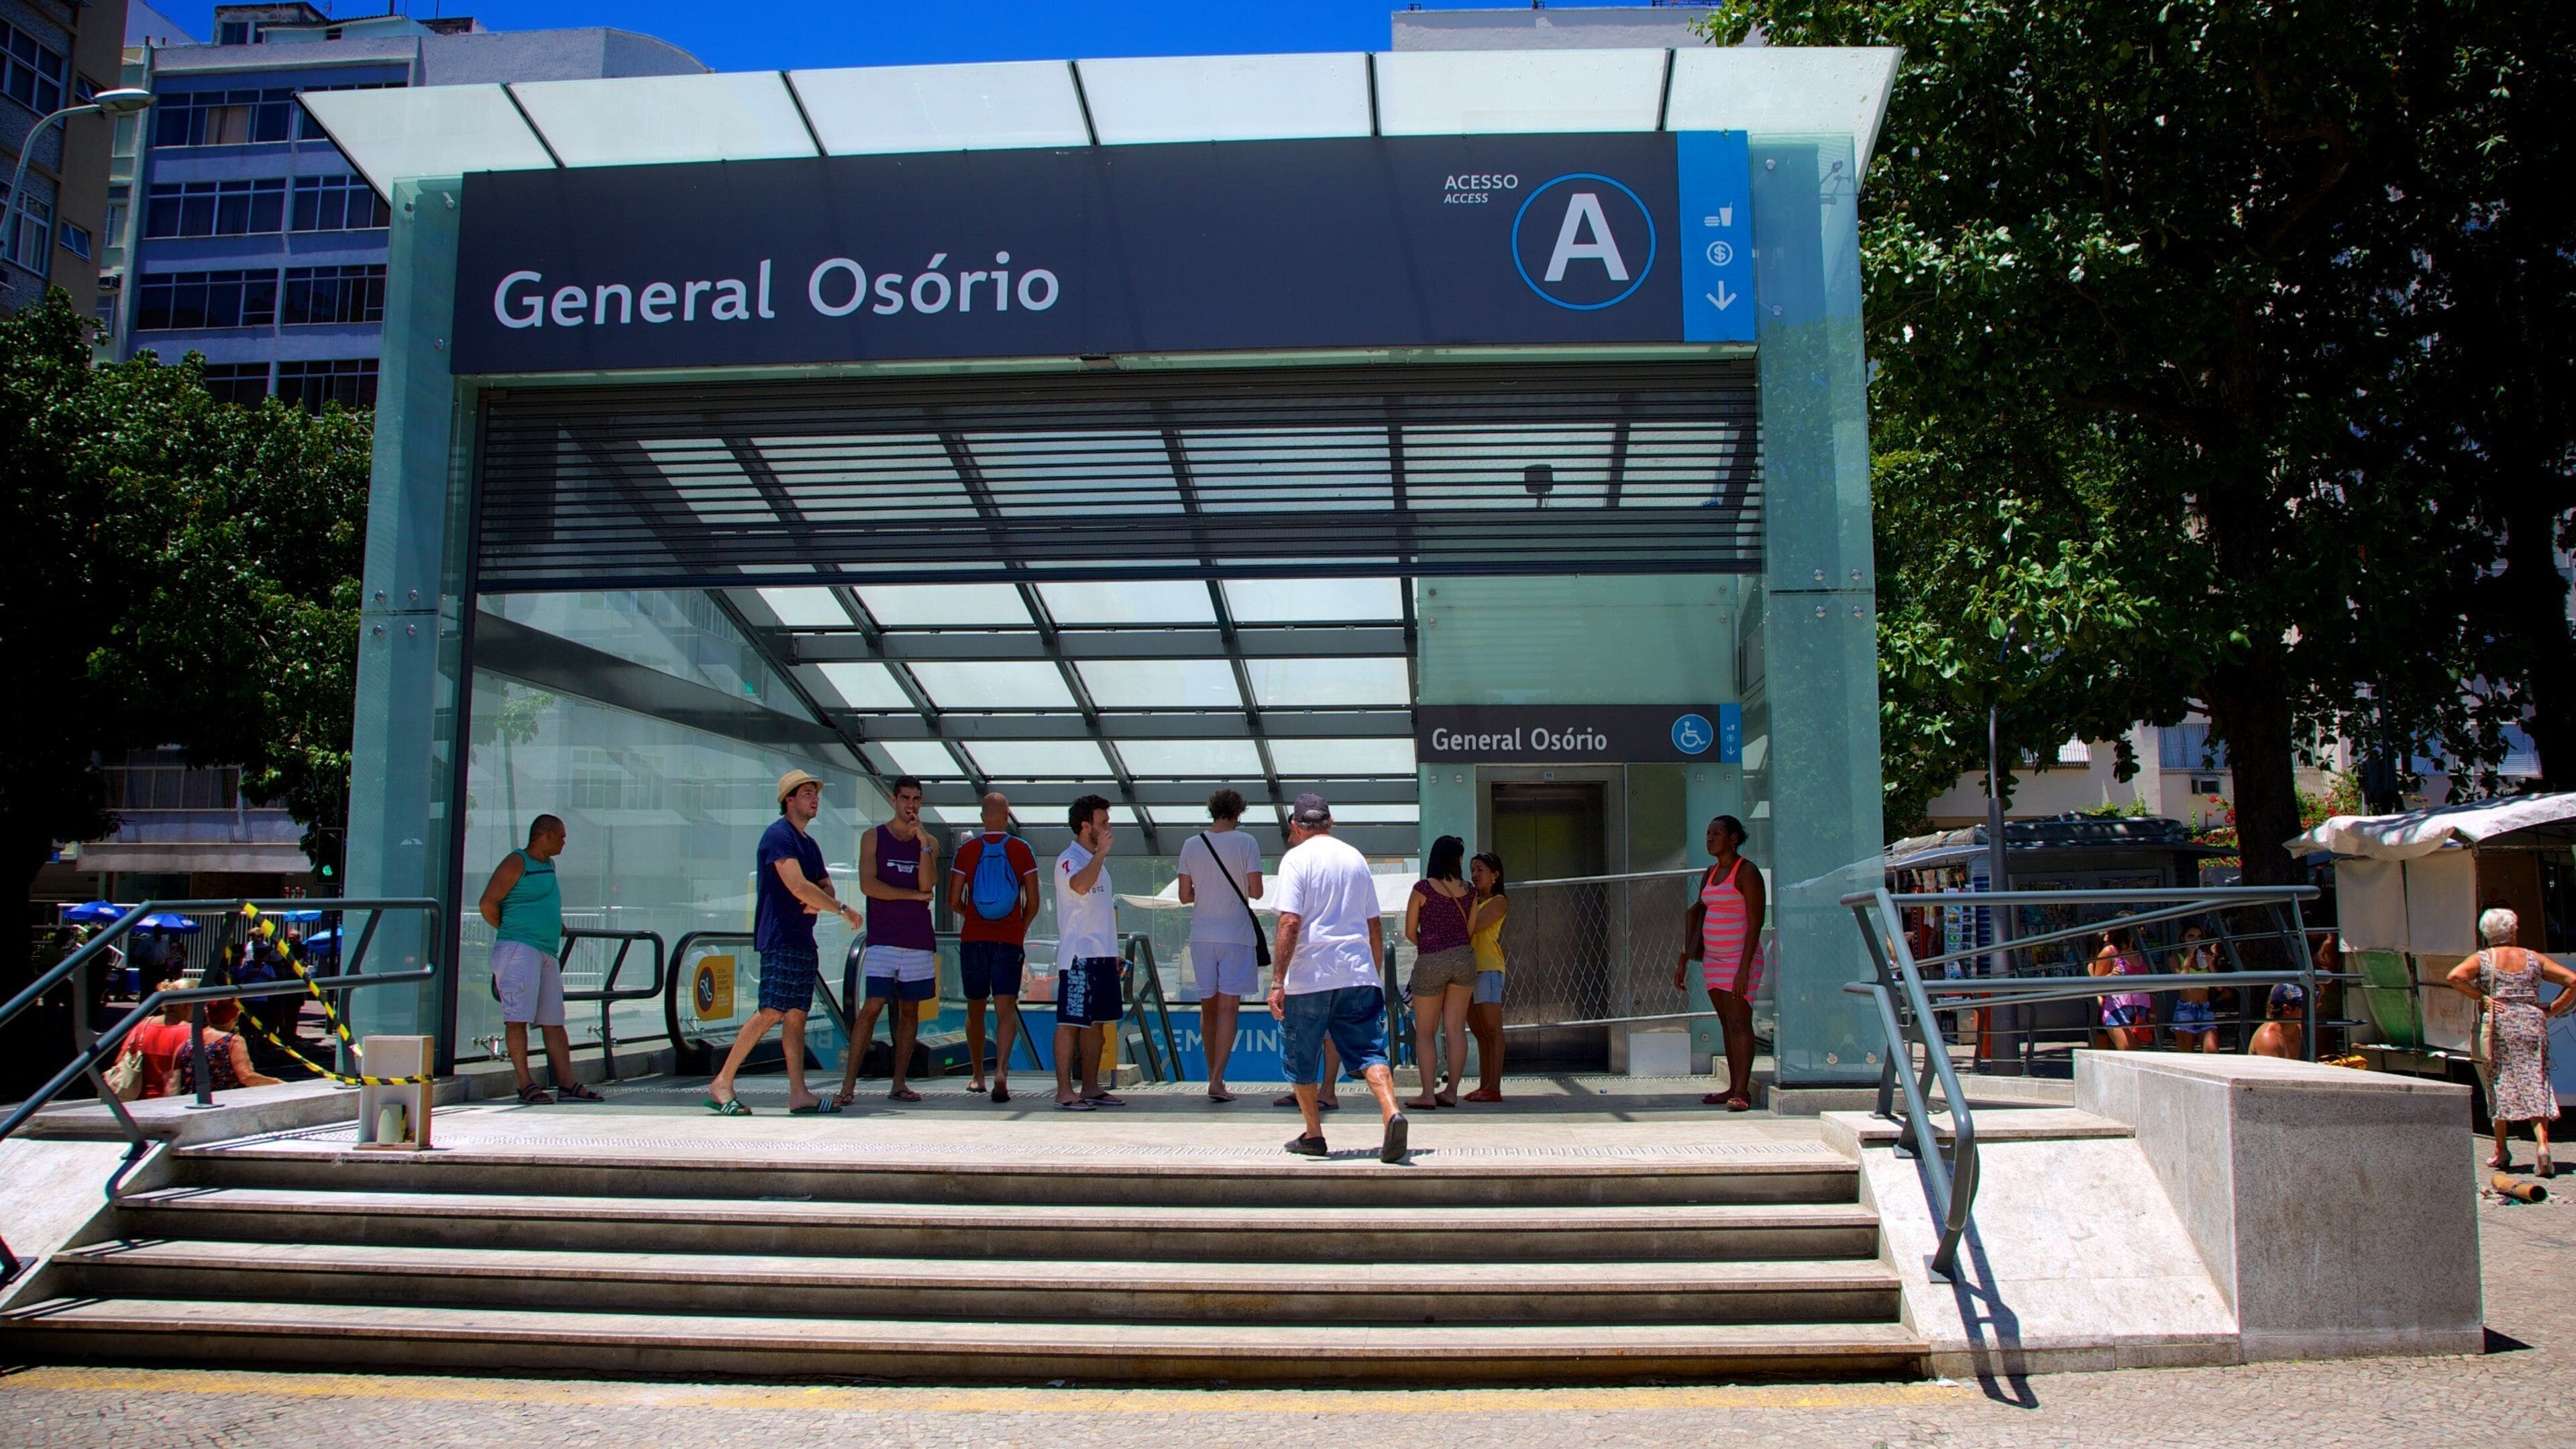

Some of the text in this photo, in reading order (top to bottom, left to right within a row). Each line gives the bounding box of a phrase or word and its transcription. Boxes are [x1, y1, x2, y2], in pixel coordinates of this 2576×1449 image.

[1444, 174, 1519, 190] ACESSO
[1444, 193, 1489, 204] ACCESS
[1544, 193, 1629, 282] A
[494, 251, 1059, 329] General Osório
[1432, 727, 1607, 751] General Osório
[1062, 860, 1071, 875] 7
